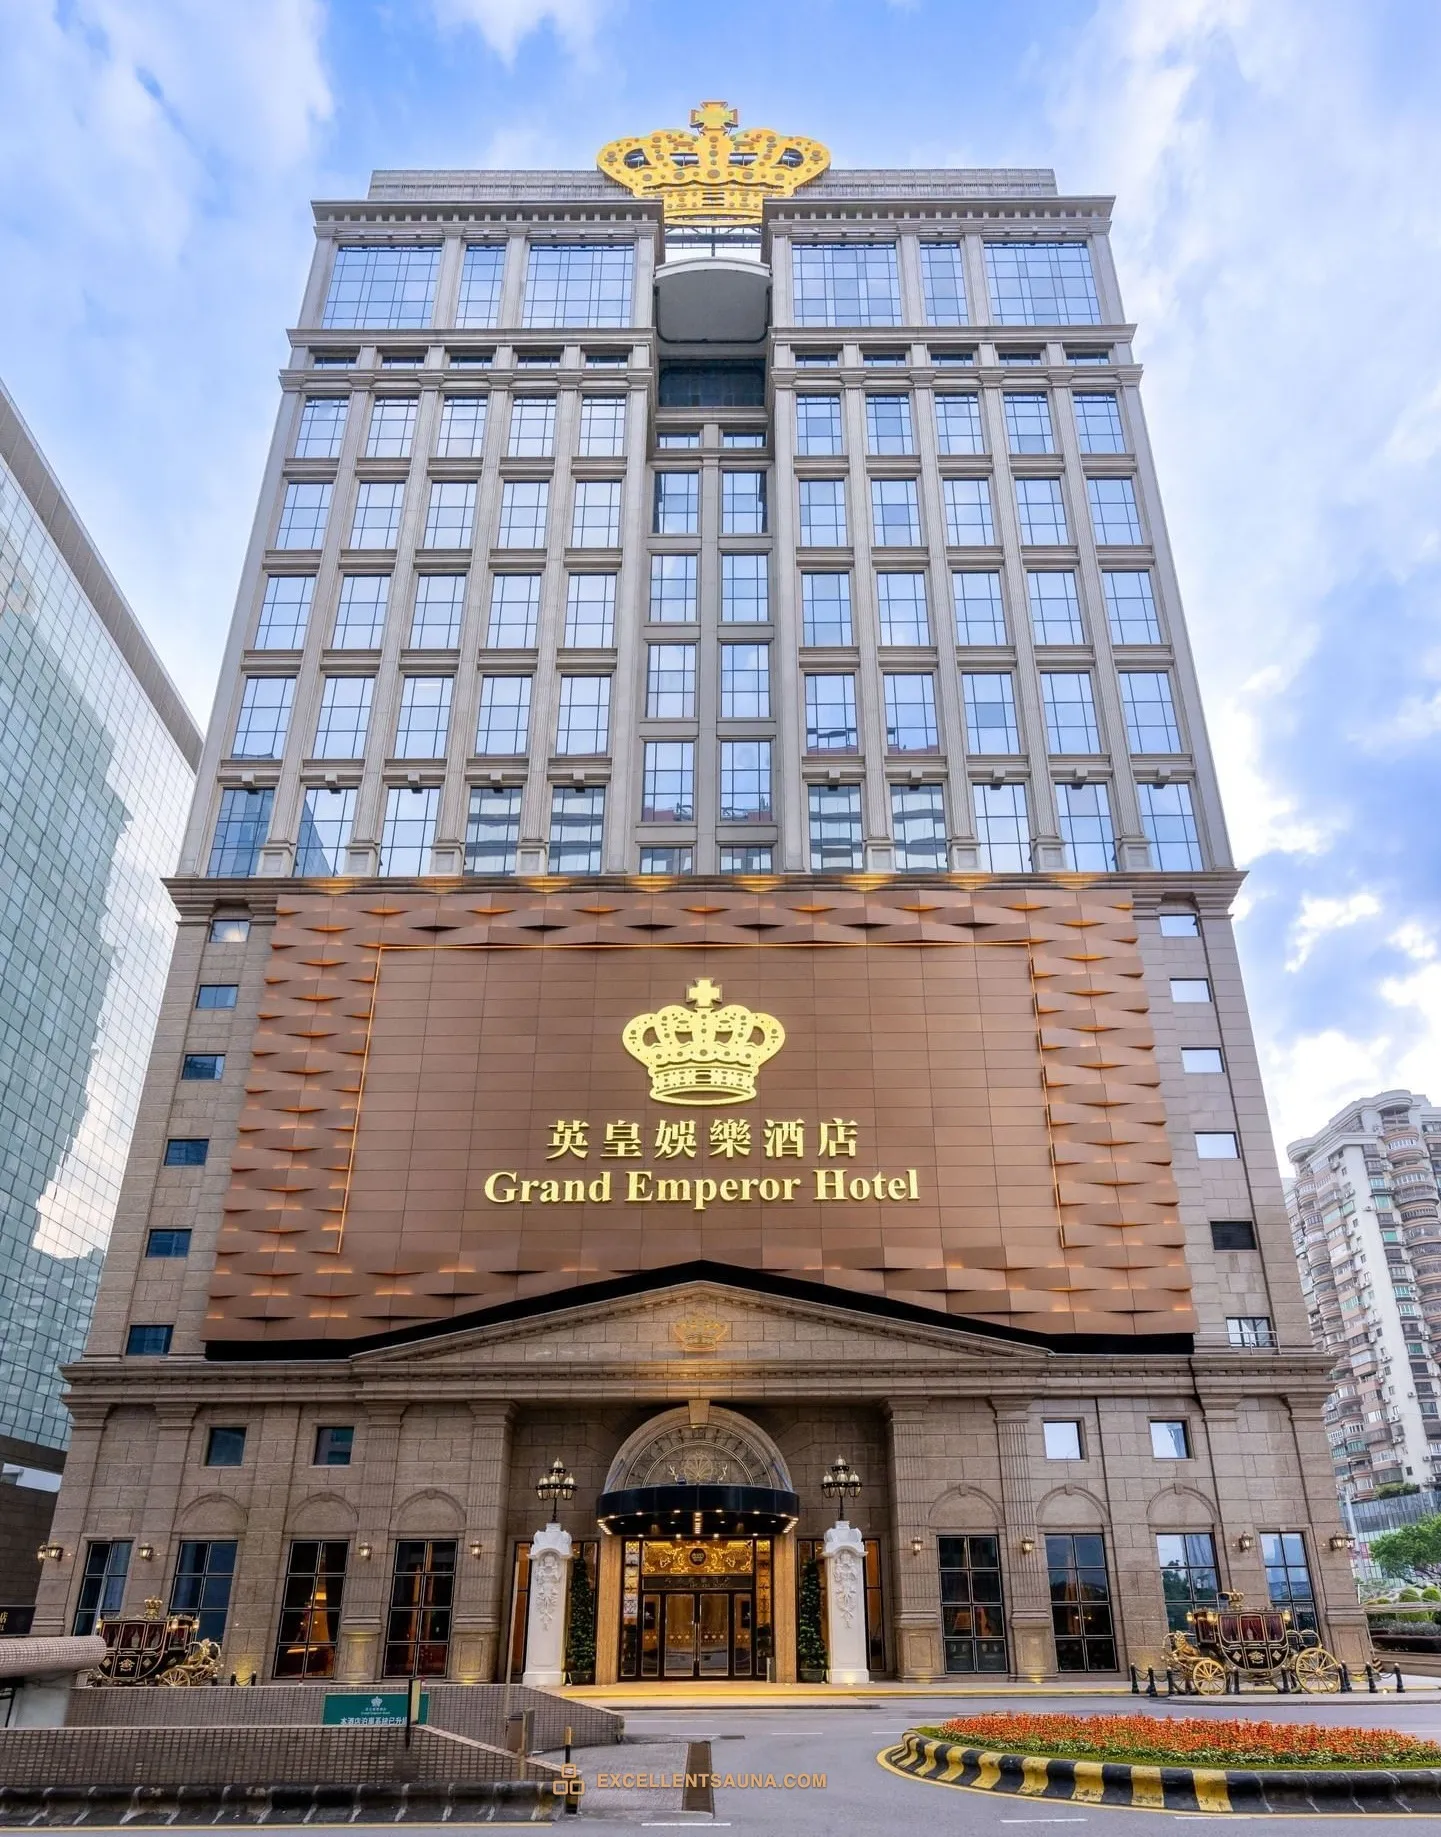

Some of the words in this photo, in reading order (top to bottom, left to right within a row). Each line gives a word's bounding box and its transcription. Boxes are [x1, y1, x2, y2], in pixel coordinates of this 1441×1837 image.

[547, 1117, 860, 1160] 英皇娛樂酒店
[484, 1171, 612, 1203] Grand
[625, 1170, 802, 1210] Emperor
[813, 1168, 921, 1200] Hotel
